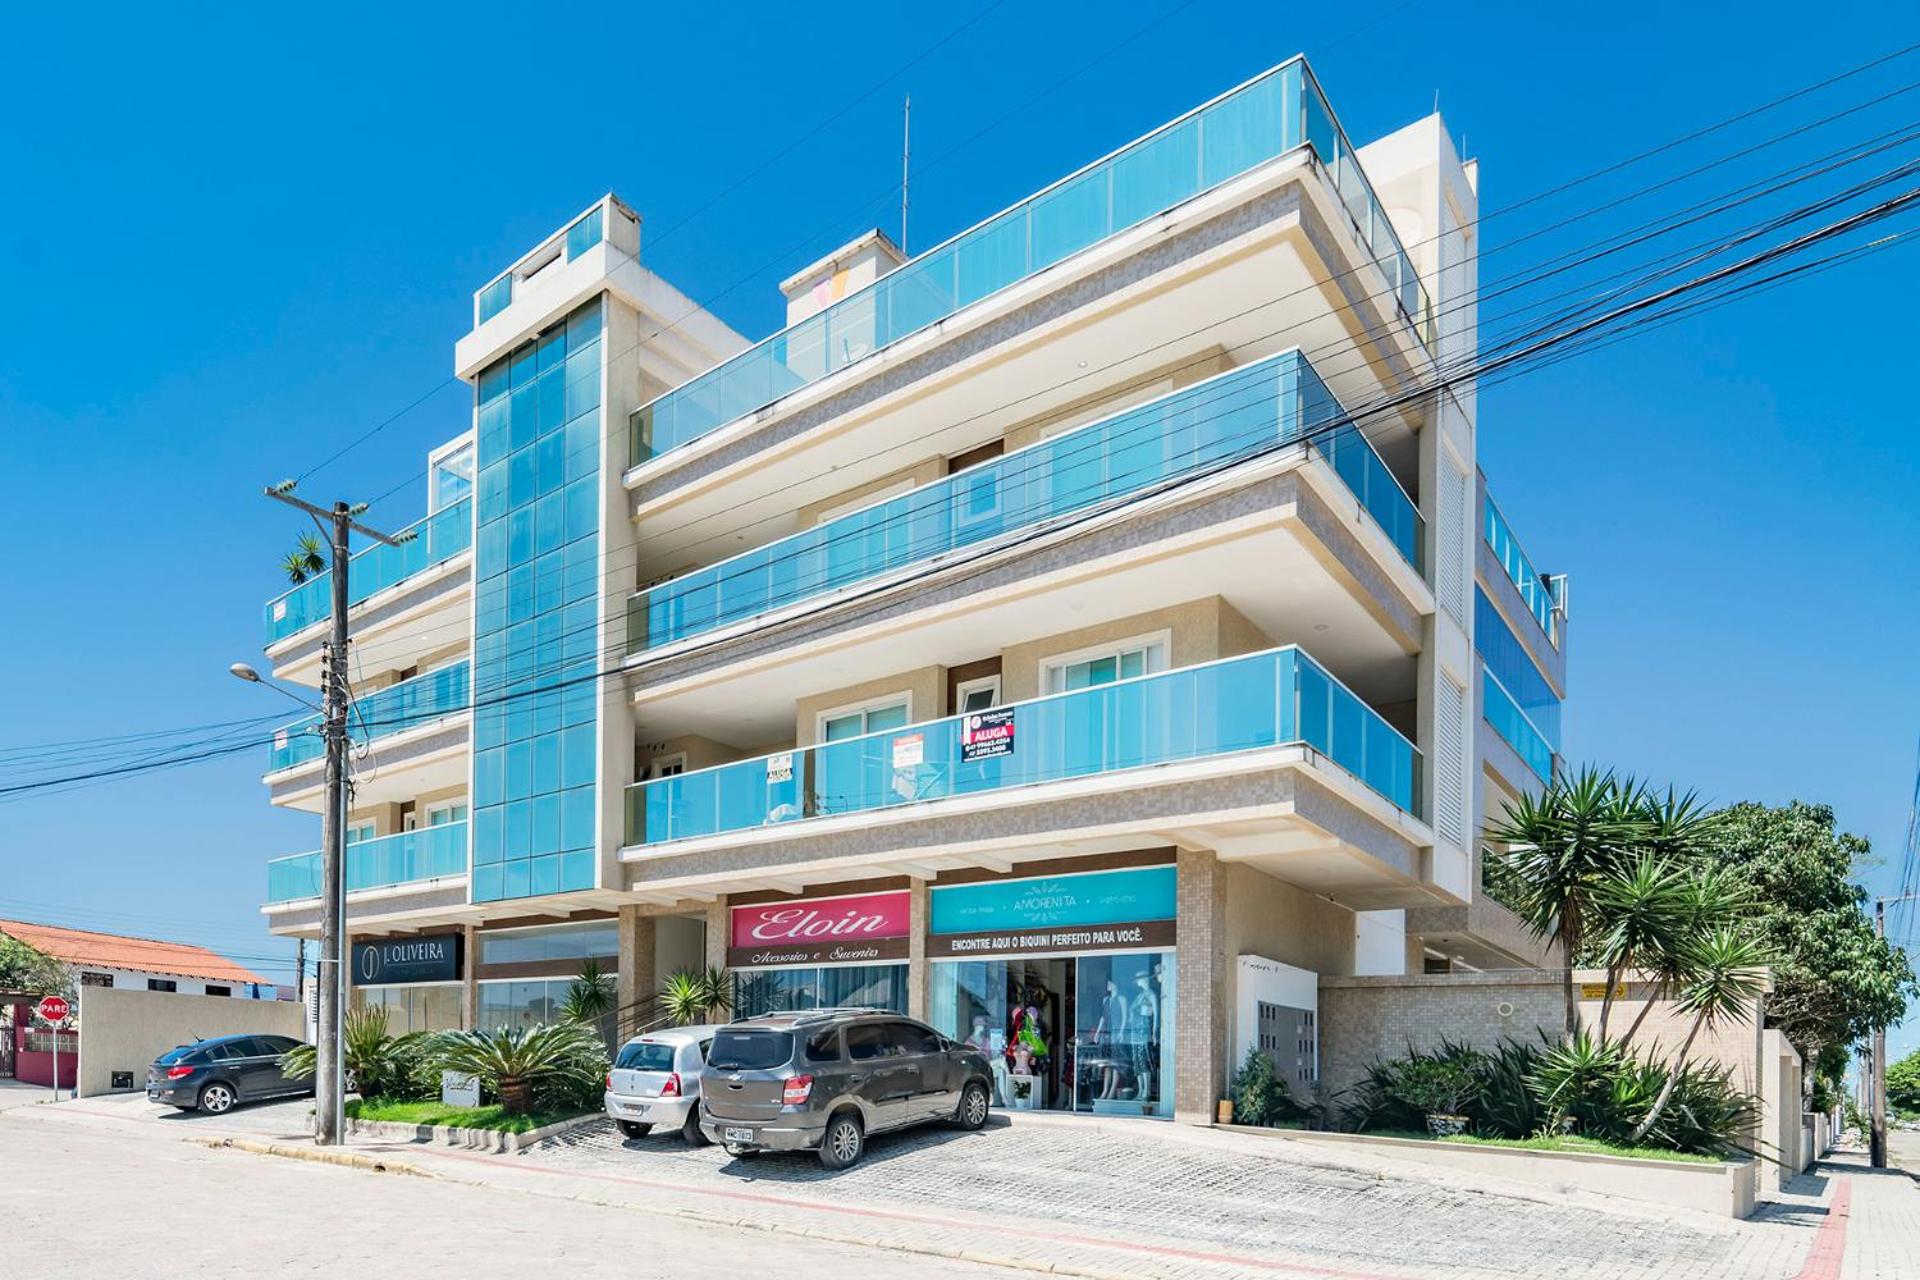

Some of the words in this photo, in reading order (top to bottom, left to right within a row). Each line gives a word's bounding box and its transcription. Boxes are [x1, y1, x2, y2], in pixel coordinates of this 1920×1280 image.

[974, 726, 1008, 742] ALUGA
[1013, 895, 1077, 912] AMORENITA
[752, 909, 888, 939] Eloin
[951, 937, 991, 951] ENCONTRE
[992, 936, 1010, 949] AQUI
[1012, 936, 1019, 948] O
[1020, 934, 1050, 947] BIQUINI
[1052, 932, 1091, 946] PERFEITO
[1092, 931, 1116, 943] PARA
[1116, 927, 1143, 942] VOCÊ.
[392, 943, 444, 962] OLIVEIRA
[813, 952, 821, 960] e
[41, 1004, 68, 1014] PARE
